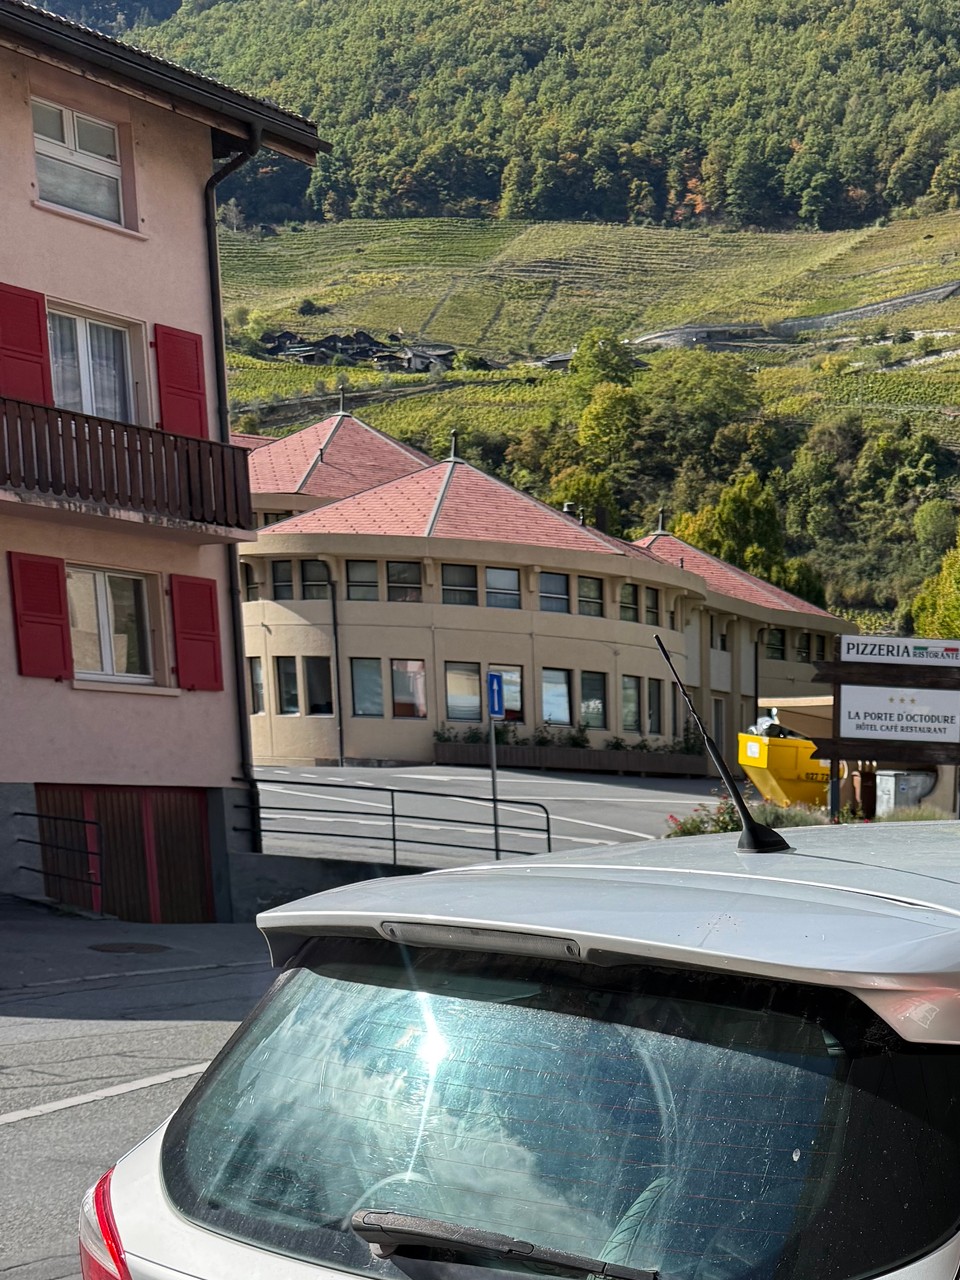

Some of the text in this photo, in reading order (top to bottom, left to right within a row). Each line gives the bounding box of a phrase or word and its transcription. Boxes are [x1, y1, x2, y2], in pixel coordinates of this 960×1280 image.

[846, 642, 960, 660] PIZZERIA RISTORANTE
[847, 711, 957, 724] LA PORTE D'OCTODURE
[855, 722, 948, 735] HÔTEL CAFÉ RESTAURANT
